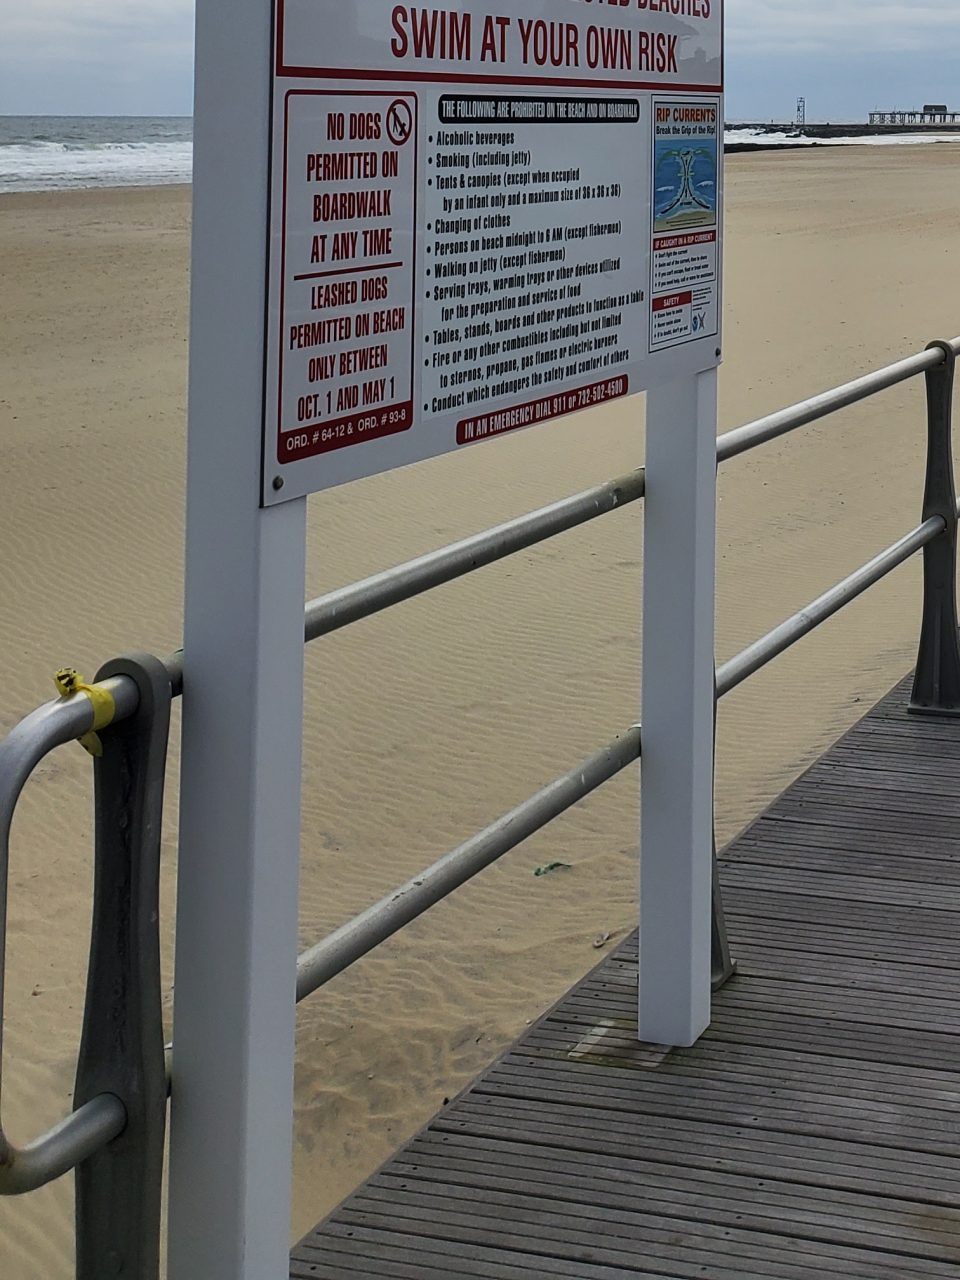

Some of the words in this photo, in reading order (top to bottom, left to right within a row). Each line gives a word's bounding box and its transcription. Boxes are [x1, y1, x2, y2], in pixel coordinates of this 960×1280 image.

[391, 5, 471, 61] SWIM
[480, 15, 510, 63] AT
[518, 18, 579, 67] YOUR
[586, 25, 632, 70] OWN
[638, 31, 678, 73] RISK
[327, 112, 344, 140] NO
[349, 112, 381, 140] DOGS
[442, 100, 455, 118] THE
[457, 100, 496, 118] FOLLOWING
[497, 101, 510, 118] ARE
[511, 101, 546, 118] PROHIBITED
[546, 102, 555, 118] ON
[556, 102, 567, 118] THE
[567, 103, 586, 118] BEACH
[586, 103, 598, 118] AND
[599, 103, 607, 118] ON
[656, 107, 670, 122] RIP
[673, 107, 716, 122] CURRENTS
[436, 131, 474, 146] Alcoholic
[475, 131, 515, 147] beverages
[656, 125, 671, 135] Break
[672, 125, 680, 135] the
[681, 125, 691, 136] Grip
[692, 125, 698, 134] of
[698, 125, 706, 134] the
[307, 152, 377, 182] PERMITTED
[382, 151, 398, 177] ON
[436, 152, 470, 169] Smoking
[472, 151, 510, 169] (including
[511, 150, 531, 167] jetty)
[436, 175, 457, 190] Tents
[460, 173, 465, 188] &
[467, 172, 501, 189] canopies
[503, 171, 530, 187] (except
[531, 169, 550, 184] when
[551, 167, 580, 183] occupied
[313, 189, 391, 222] BOARDWALK
[443, 196, 452, 213] by
[454, 197, 464, 210] an
[466, 194, 489, 209] infant
[490, 193, 506, 209] only
[507, 191, 520, 206] and
[522, 193, 526, 204] a
[528, 189, 559, 205] maximum
[560, 187, 574, 201] size
[574, 187, 581, 200] of
[582, 185, 590, 199] 36
[592, 187, 596, 199] x
[596, 185, 605, 198] 36
[606, 186, 610, 197] x
[435, 217, 471, 234] Changing
[473, 215, 481, 230] of
[483, 214, 511, 230] clothes
[435, 240, 468, 257] Persons
[470, 239, 479, 252] on
[481, 234, 504, 251] beach
[505, 230, 536, 247] midnight
[537, 230, 544, 243] to
[546, 228, 550, 242] 6
[552, 227, 563, 241] AM
[564, 225, 588, 241] (except
[589, 220, 622, 237] fishermen)
[311, 234, 327, 263] AT
[331, 231, 358, 261] ANY
[362, 228, 392, 257] TIME
[434, 261, 467, 279] Walking
[469, 260, 478, 273] on
[480, 257, 498, 275] jetty
[500, 252, 527, 271] (except
[528, 246, 566, 265] fishermen)
[311, 281, 357, 310] LEASHED
[361, 276, 388, 302] DOGS
[433, 283, 465, 301] Serving
[467, 280, 491, 296] trays,
[493, 274, 525, 291] warming
[527, 271, 545, 289] trays
[546, 270, 554, 282] or
[556, 266, 574, 281] other
[575, 262, 598, 277] devices
[441, 306, 454, 322] for
[456, 304, 468, 319] the
[470, 295, 516, 319] preparation
[517, 292, 531, 307] and
[532, 288, 558, 305] service
[559, 285, 566, 300] of
[567, 282, 581, 298] food
[663, 296, 680, 307] SAFETY
[290, 316, 351, 350] PERMITTED
[355, 312, 369, 338] ON
[373, 307, 405, 335] BEACH
[433, 327, 462, 345] Tables,
[464, 321, 493, 339] stands,
[494, 315, 520, 333] boards
[522, 311, 535, 327] and
[536, 309, 555, 325] other
[556, 302, 585, 322] products
[586, 301, 592, 314] to
[618, 294, 625, 306] as
[432, 351, 450, 368] Fire
[452, 350, 461, 364] or
[463, 346, 478, 361] any
[479, 341, 500, 358] other
[502, 330, 548, 352] combustibles
[549, 323, 579, 341] including
[580, 320, 590, 334] but
[591, 318, 601, 332] not
[308, 354, 336, 383] ONLY
[339, 344, 388, 376] BETWEEN
[440, 374, 448, 388] to
[486, 359, 519, 380] propane,
[521, 354, 534, 371] gas
[535, 348, 558, 365] flames
[559, 346, 567, 359] or
[568, 339, 593, 357] electric
[298, 394, 321, 421] OCT.
[326, 390, 332, 414] 1
[337, 384, 359, 412] AND
[362, 378, 386, 405] MAY
[390, 376, 395, 399] 1
[432, 391, 465, 413] Conduct
[466, 384, 490, 404] which
[491, 378, 530, 397] endangers
[531, 371, 542, 386] the
[543, 366, 564, 383] safety
[565, 362, 577, 377] and
[286, 435, 309, 451] ORD.
[312, 431, 319, 444] #
[321, 424, 345, 441] 64-12
[347, 422, 353, 434] &
[358, 417, 379, 432] ORD.
[381, 413, 387, 425] #
[388, 408, 406, 423] 93-8
[464, 421, 474, 440] IN
[476, 418, 488, 437] AN
[489, 405, 534, 433] EMERGENCY
[535, 400, 551, 419] DIAL
[553, 395, 566, 413] 911
[568, 395, 577, 409] or
